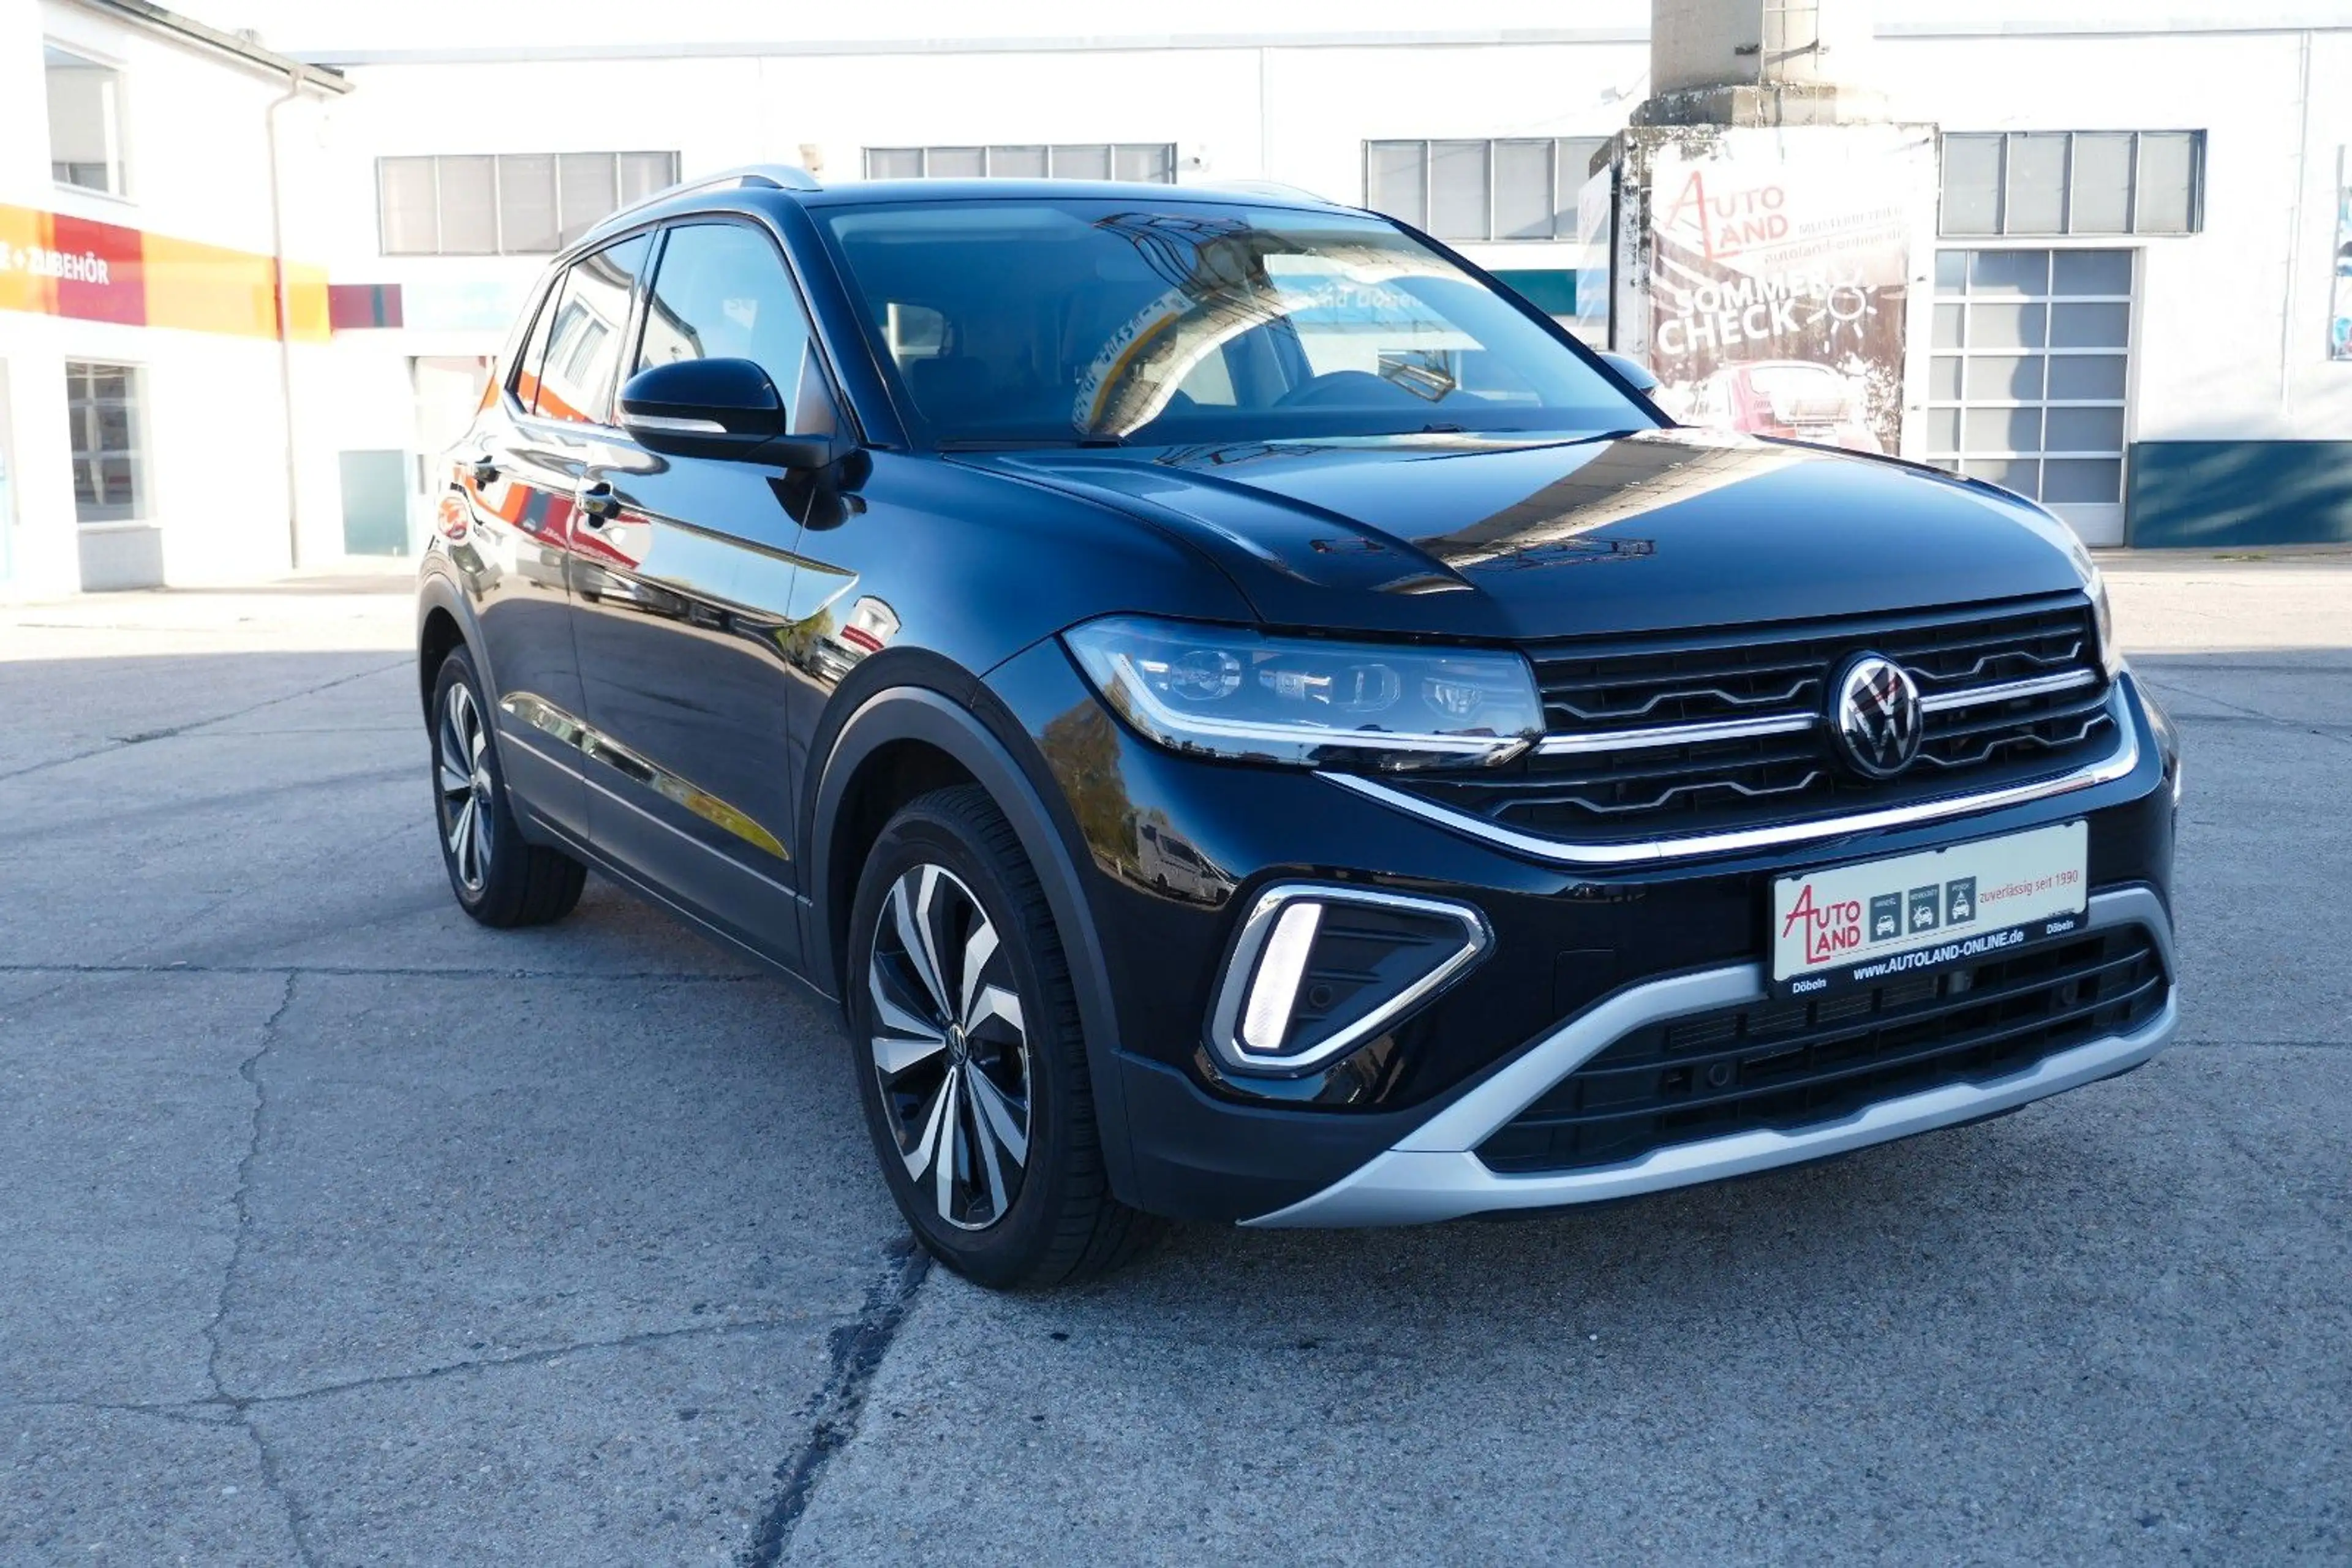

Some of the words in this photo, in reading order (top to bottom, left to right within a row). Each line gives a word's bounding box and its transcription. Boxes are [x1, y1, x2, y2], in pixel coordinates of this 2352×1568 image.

[26, 246, 110, 285] ZUBEHÖR
[1657, 298, 1802, 356] CHECK
[1783, 884, 1861, 938] AUTO
[1979, 880, 2033, 903] zuverlässig
[2035, 875, 2052, 891] seit
[2056, 870, 2079, 886] 1990
[1793, 979, 1826, 993] Döbeln
[1853, 930, 2024, 981] www.AUTOLAND-ONLINE.de
[2046, 920, 2075, 934] Döbeln
